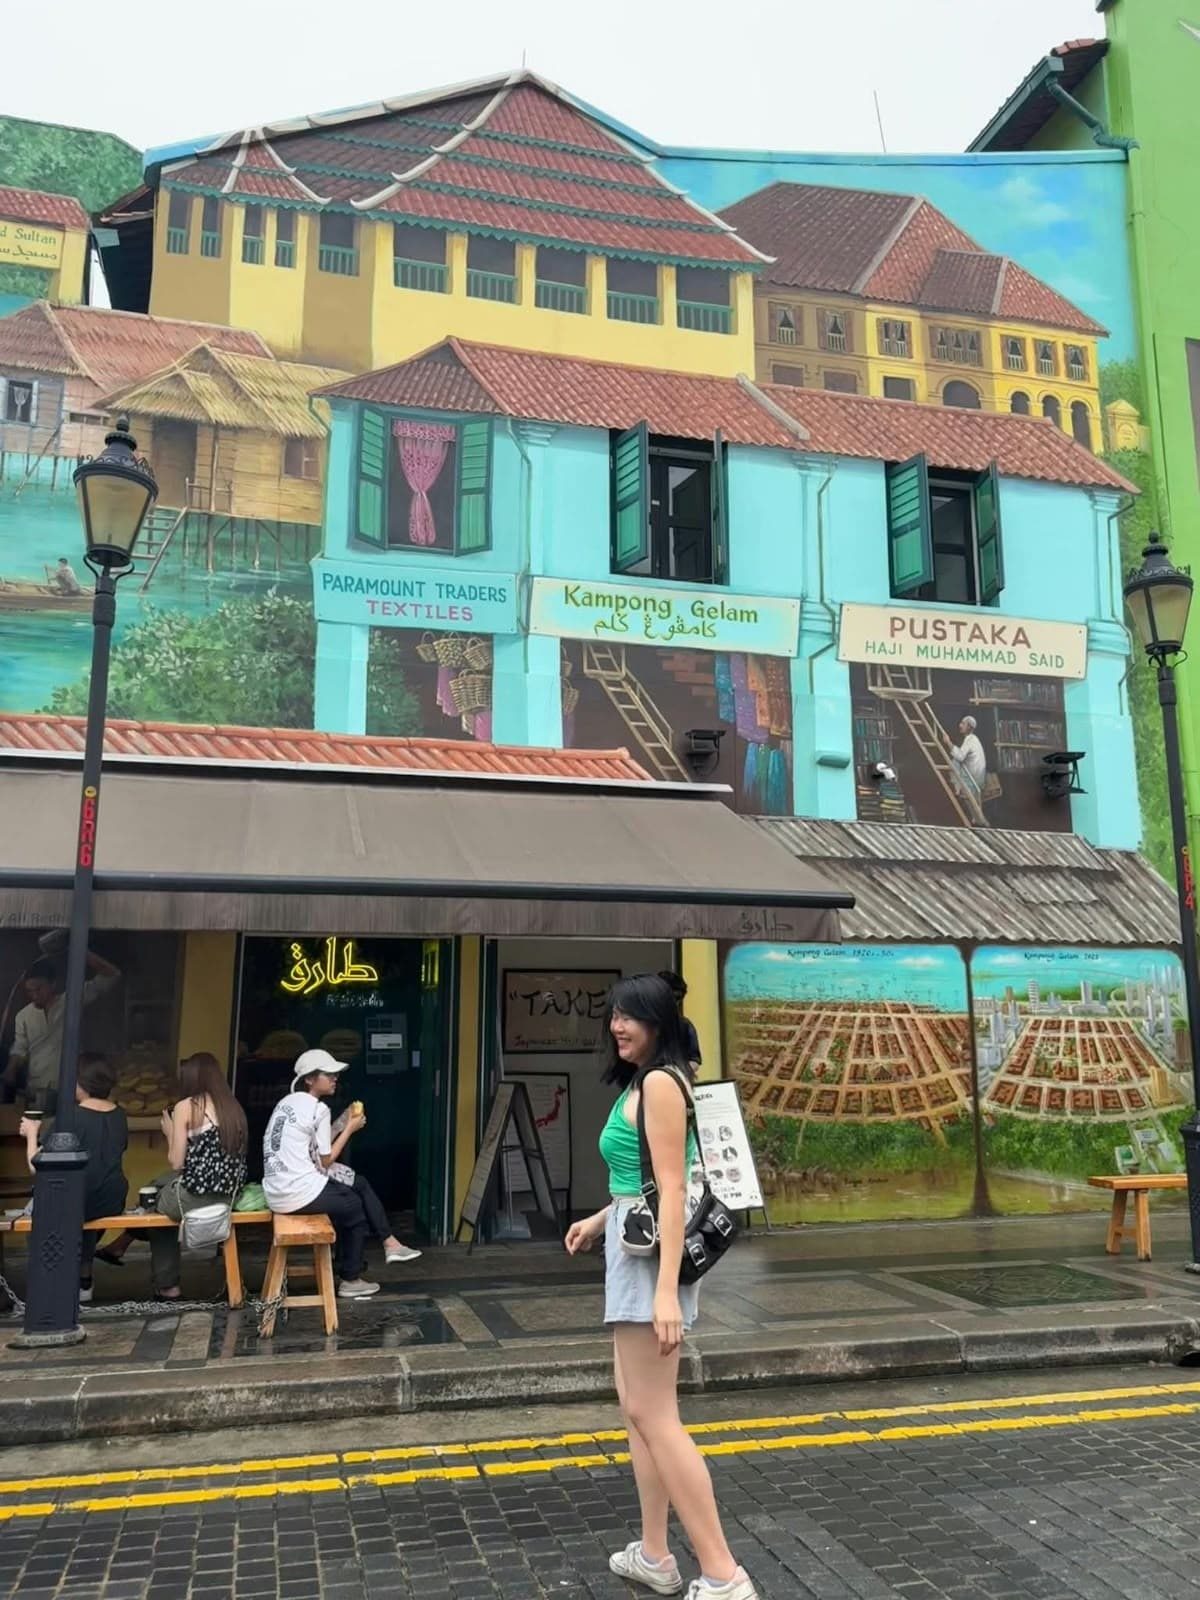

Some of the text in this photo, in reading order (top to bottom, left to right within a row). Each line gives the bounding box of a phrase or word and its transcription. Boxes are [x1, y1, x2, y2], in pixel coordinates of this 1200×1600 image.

[14, 228, 57, 245] Sultan
[322, 573, 507, 604] PARAMOUNT TRADERS
[366, 600, 473, 622] TEXTILES
[564, 585, 758, 623] Kampong Gelam
[889, 616, 1032, 649] PUSTAKA
[865, 641, 1065, 669] HAJI MUHAMMAD SAID
[738, 908, 794, 935] طارق
[280, 936, 379, 994] طارق
